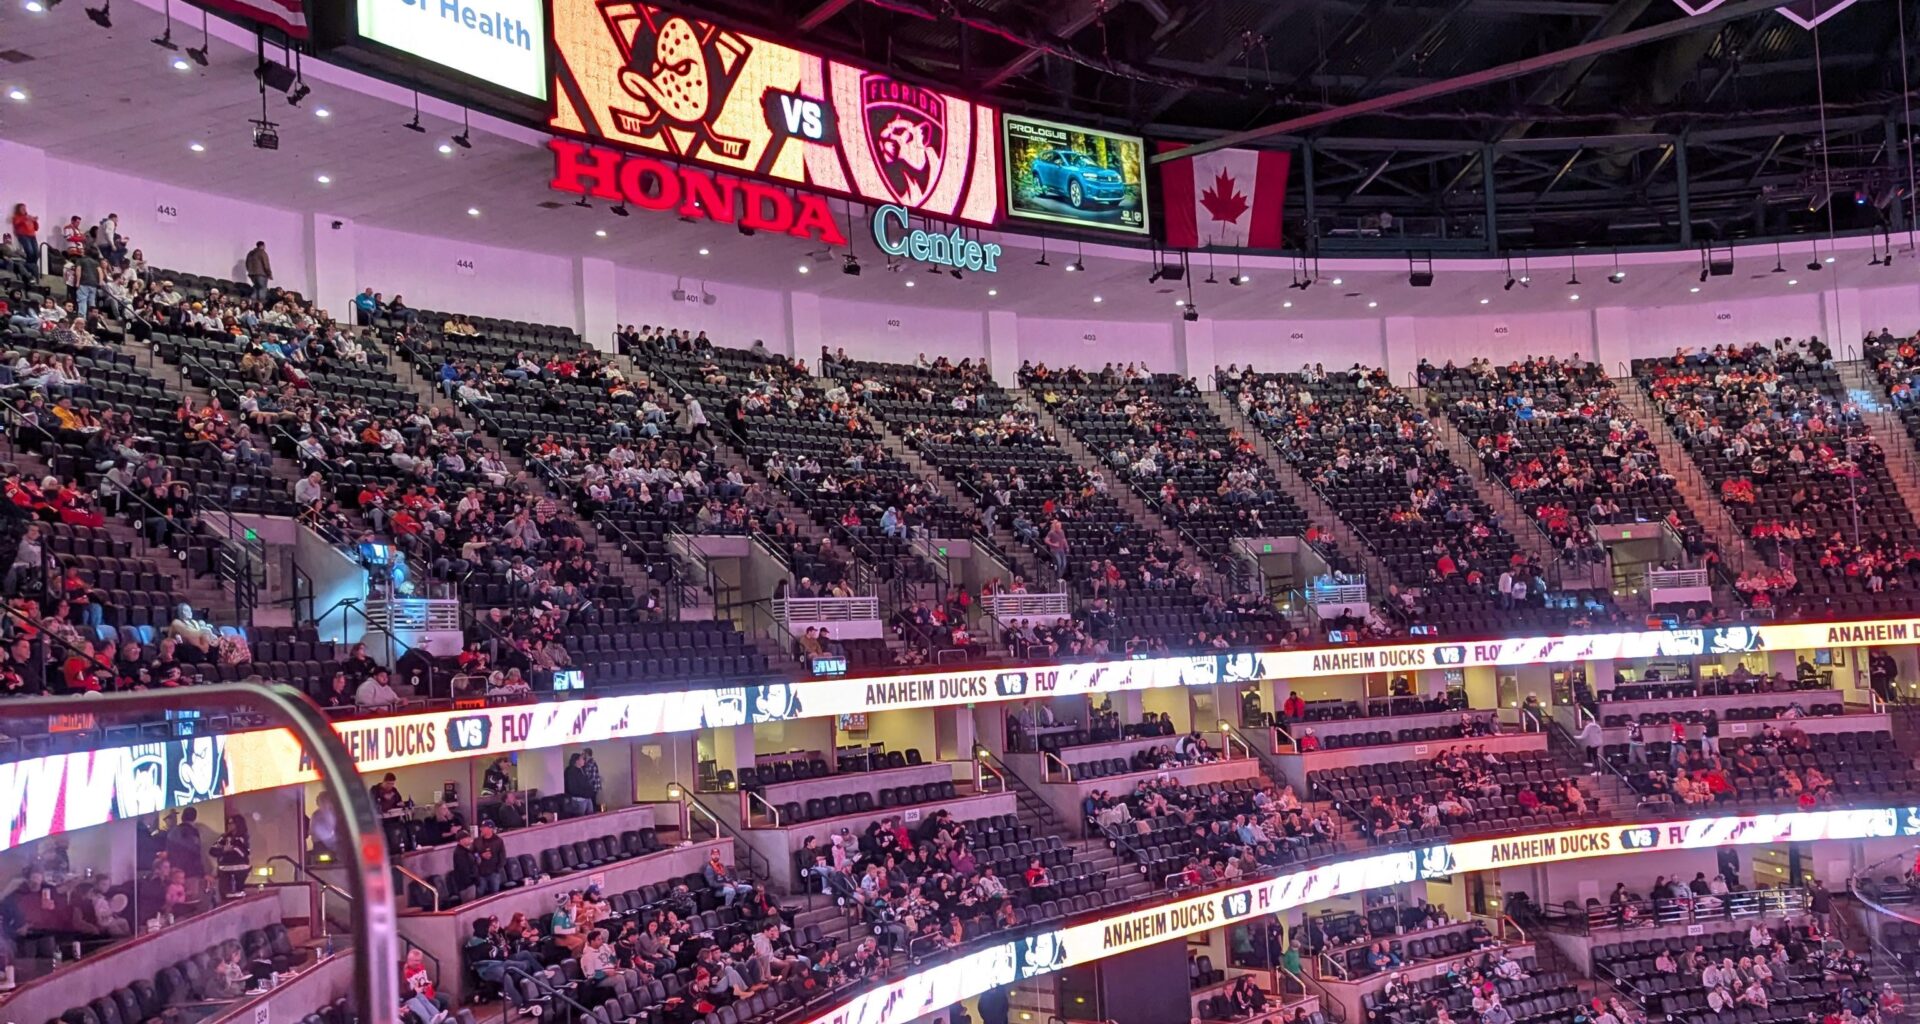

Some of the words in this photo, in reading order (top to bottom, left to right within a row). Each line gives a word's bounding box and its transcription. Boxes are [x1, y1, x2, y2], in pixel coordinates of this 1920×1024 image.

[440, 0, 531, 51] Health
[870, 81, 938, 118] FLORIDA
[780, 94, 823, 139] VS
[1009, 122, 1067, 140] PROLOGUE
[547, 138, 848, 247] HONDA
[157, 205, 177, 217] 443
[871, 202, 1002, 273] Center
[456, 259, 474, 270] 444
[686, 294, 699, 303] 401
[887, 319, 900, 327] 402
[1716, 312, 1731, 320] 406
[1083, 333, 1096, 341] 403
[1290, 332, 1303, 340] 404
[1827, 623, 1908, 643] ANAHEIM
[1312, 650, 1376, 671] ANAHEIM
[1379, 647, 1426, 667] DUCKS
[1439, 646, 1461, 664] VS
[865, 678, 935, 706] ANAHEIM
[939, 675, 988, 700] DUCKS
[1002, 674, 1022, 695] VS
[384, 720, 436, 759] DUCKS
[455, 718, 484, 749] VS
[1490, 836, 1557, 863] ANAHEIM
[1560, 832, 1611, 854] DUCKS
[1628, 828, 1653, 849] VS
[1103, 911, 1168, 949] ANAHEIM
[1171, 901, 1216, 932] DUCKS
[1228, 893, 1249, 917] VS
